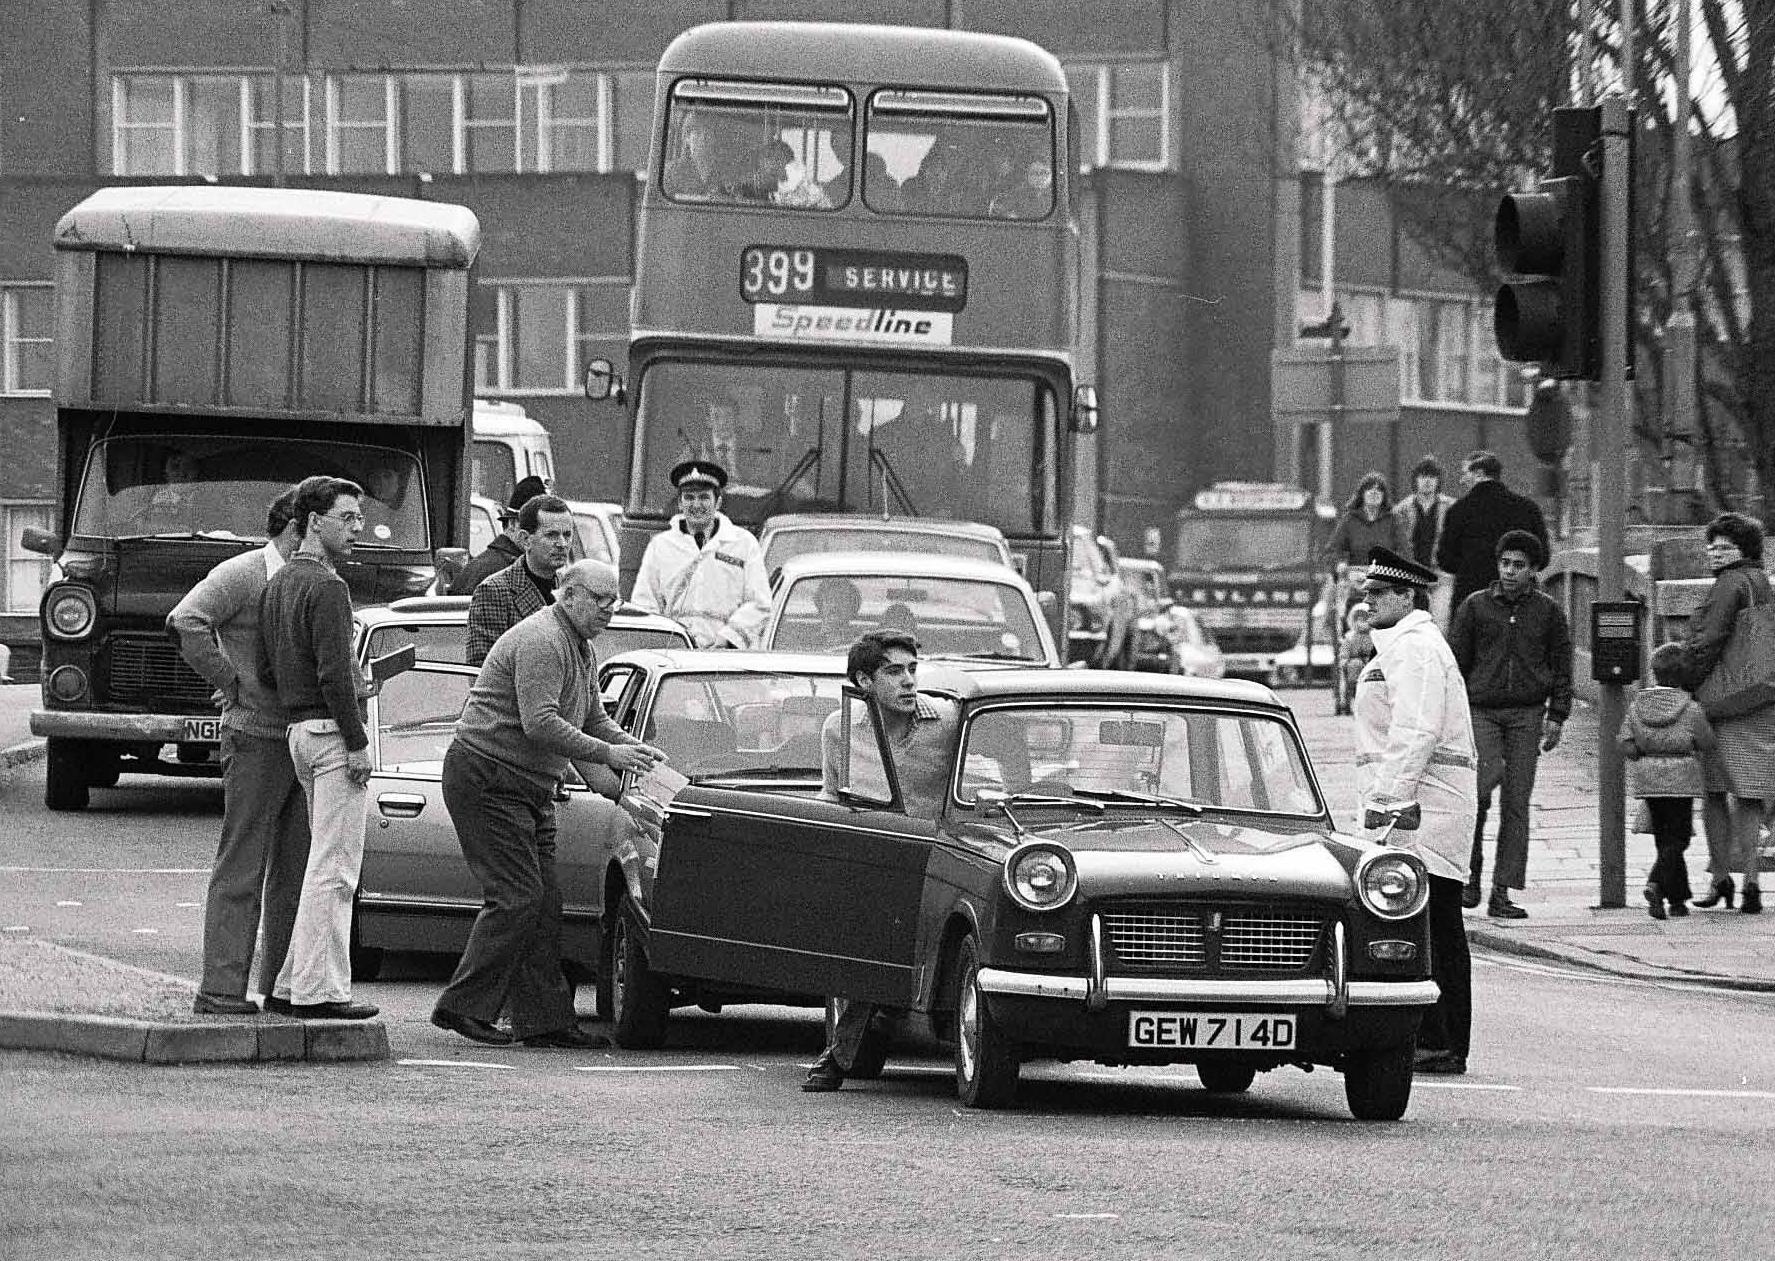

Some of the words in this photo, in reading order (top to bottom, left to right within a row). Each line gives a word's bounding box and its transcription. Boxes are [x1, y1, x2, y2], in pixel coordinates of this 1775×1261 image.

[744, 250, 815, 295] 399
[845, 267, 956, 295] SERVICE
[772, 304, 932, 337] Speedline
[1134, 1016, 1198, 1046] GEW
[1206, 1018, 1294, 1047] 714D
